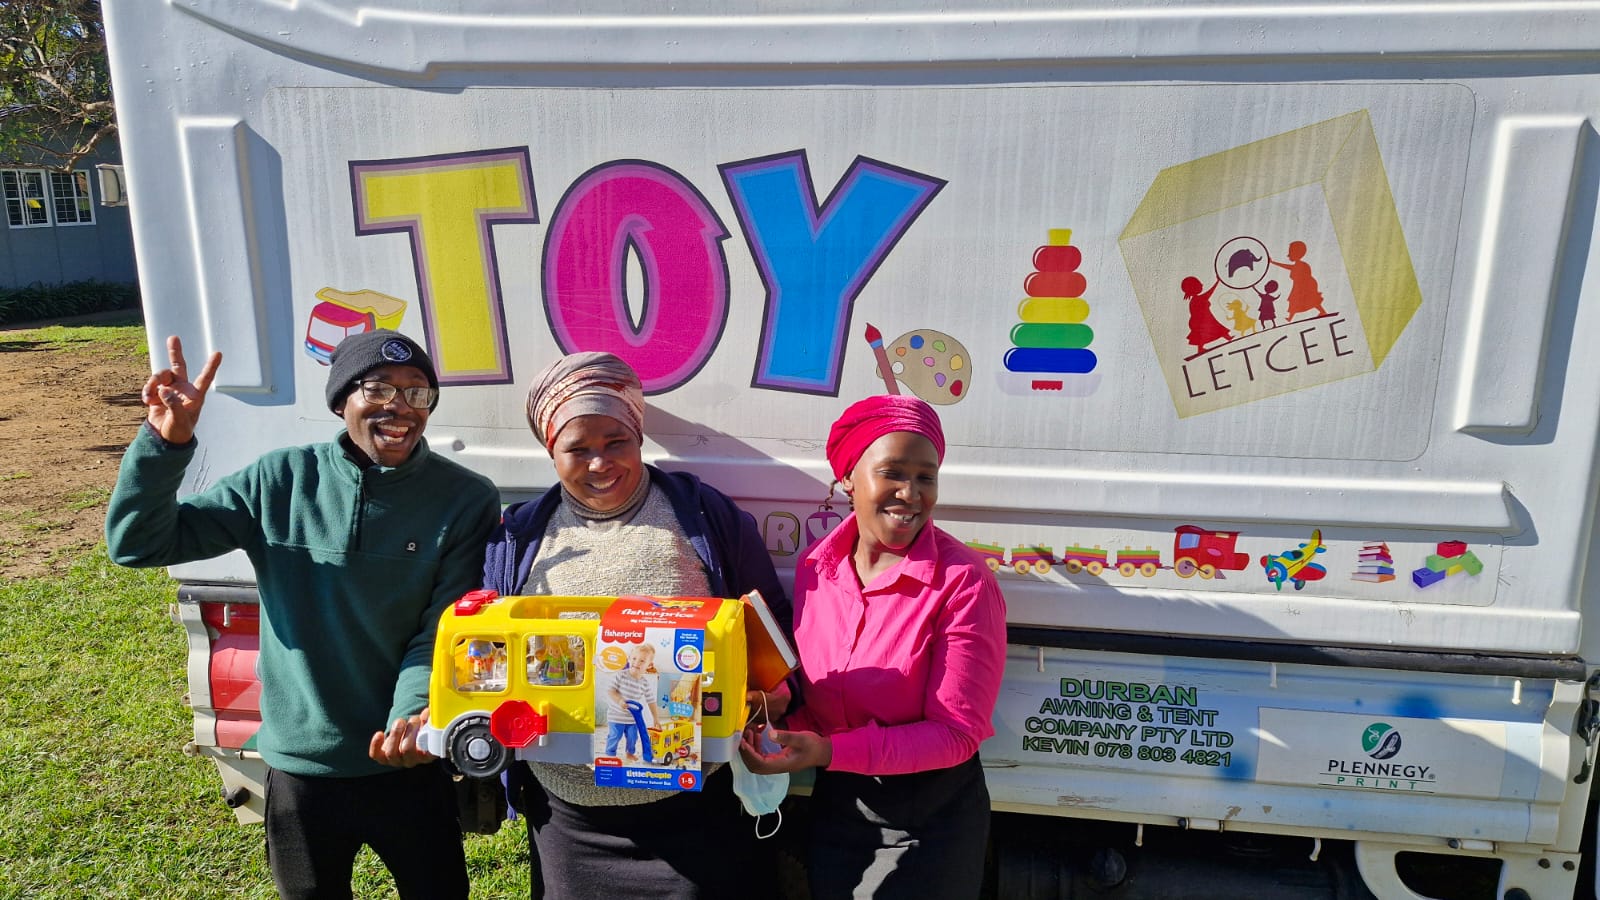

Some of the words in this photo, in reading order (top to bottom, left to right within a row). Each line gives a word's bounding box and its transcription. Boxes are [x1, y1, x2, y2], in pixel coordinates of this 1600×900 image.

[348, 146, 948, 397] TOY
[1182, 318, 1354, 398] LETCEE
[1060, 678, 1198, 706] DURBAN
[1039, 698, 1131, 720] AWNING
[1137, 708, 1153, 722] &
[1158, 707, 1218, 727] TENT
[1025, 718, 1137, 740] COMPANY
[1141, 728, 1187, 745] PTY
[1190, 730, 1234, 748] LTD
[1022, 735, 1089, 756] KEVIN
[1094, 742, 1133, 760] 078
[1138, 745, 1177, 762] 803
[1181, 748, 1232, 767] 4821
[1337, 776, 1417, 790] PRINT
